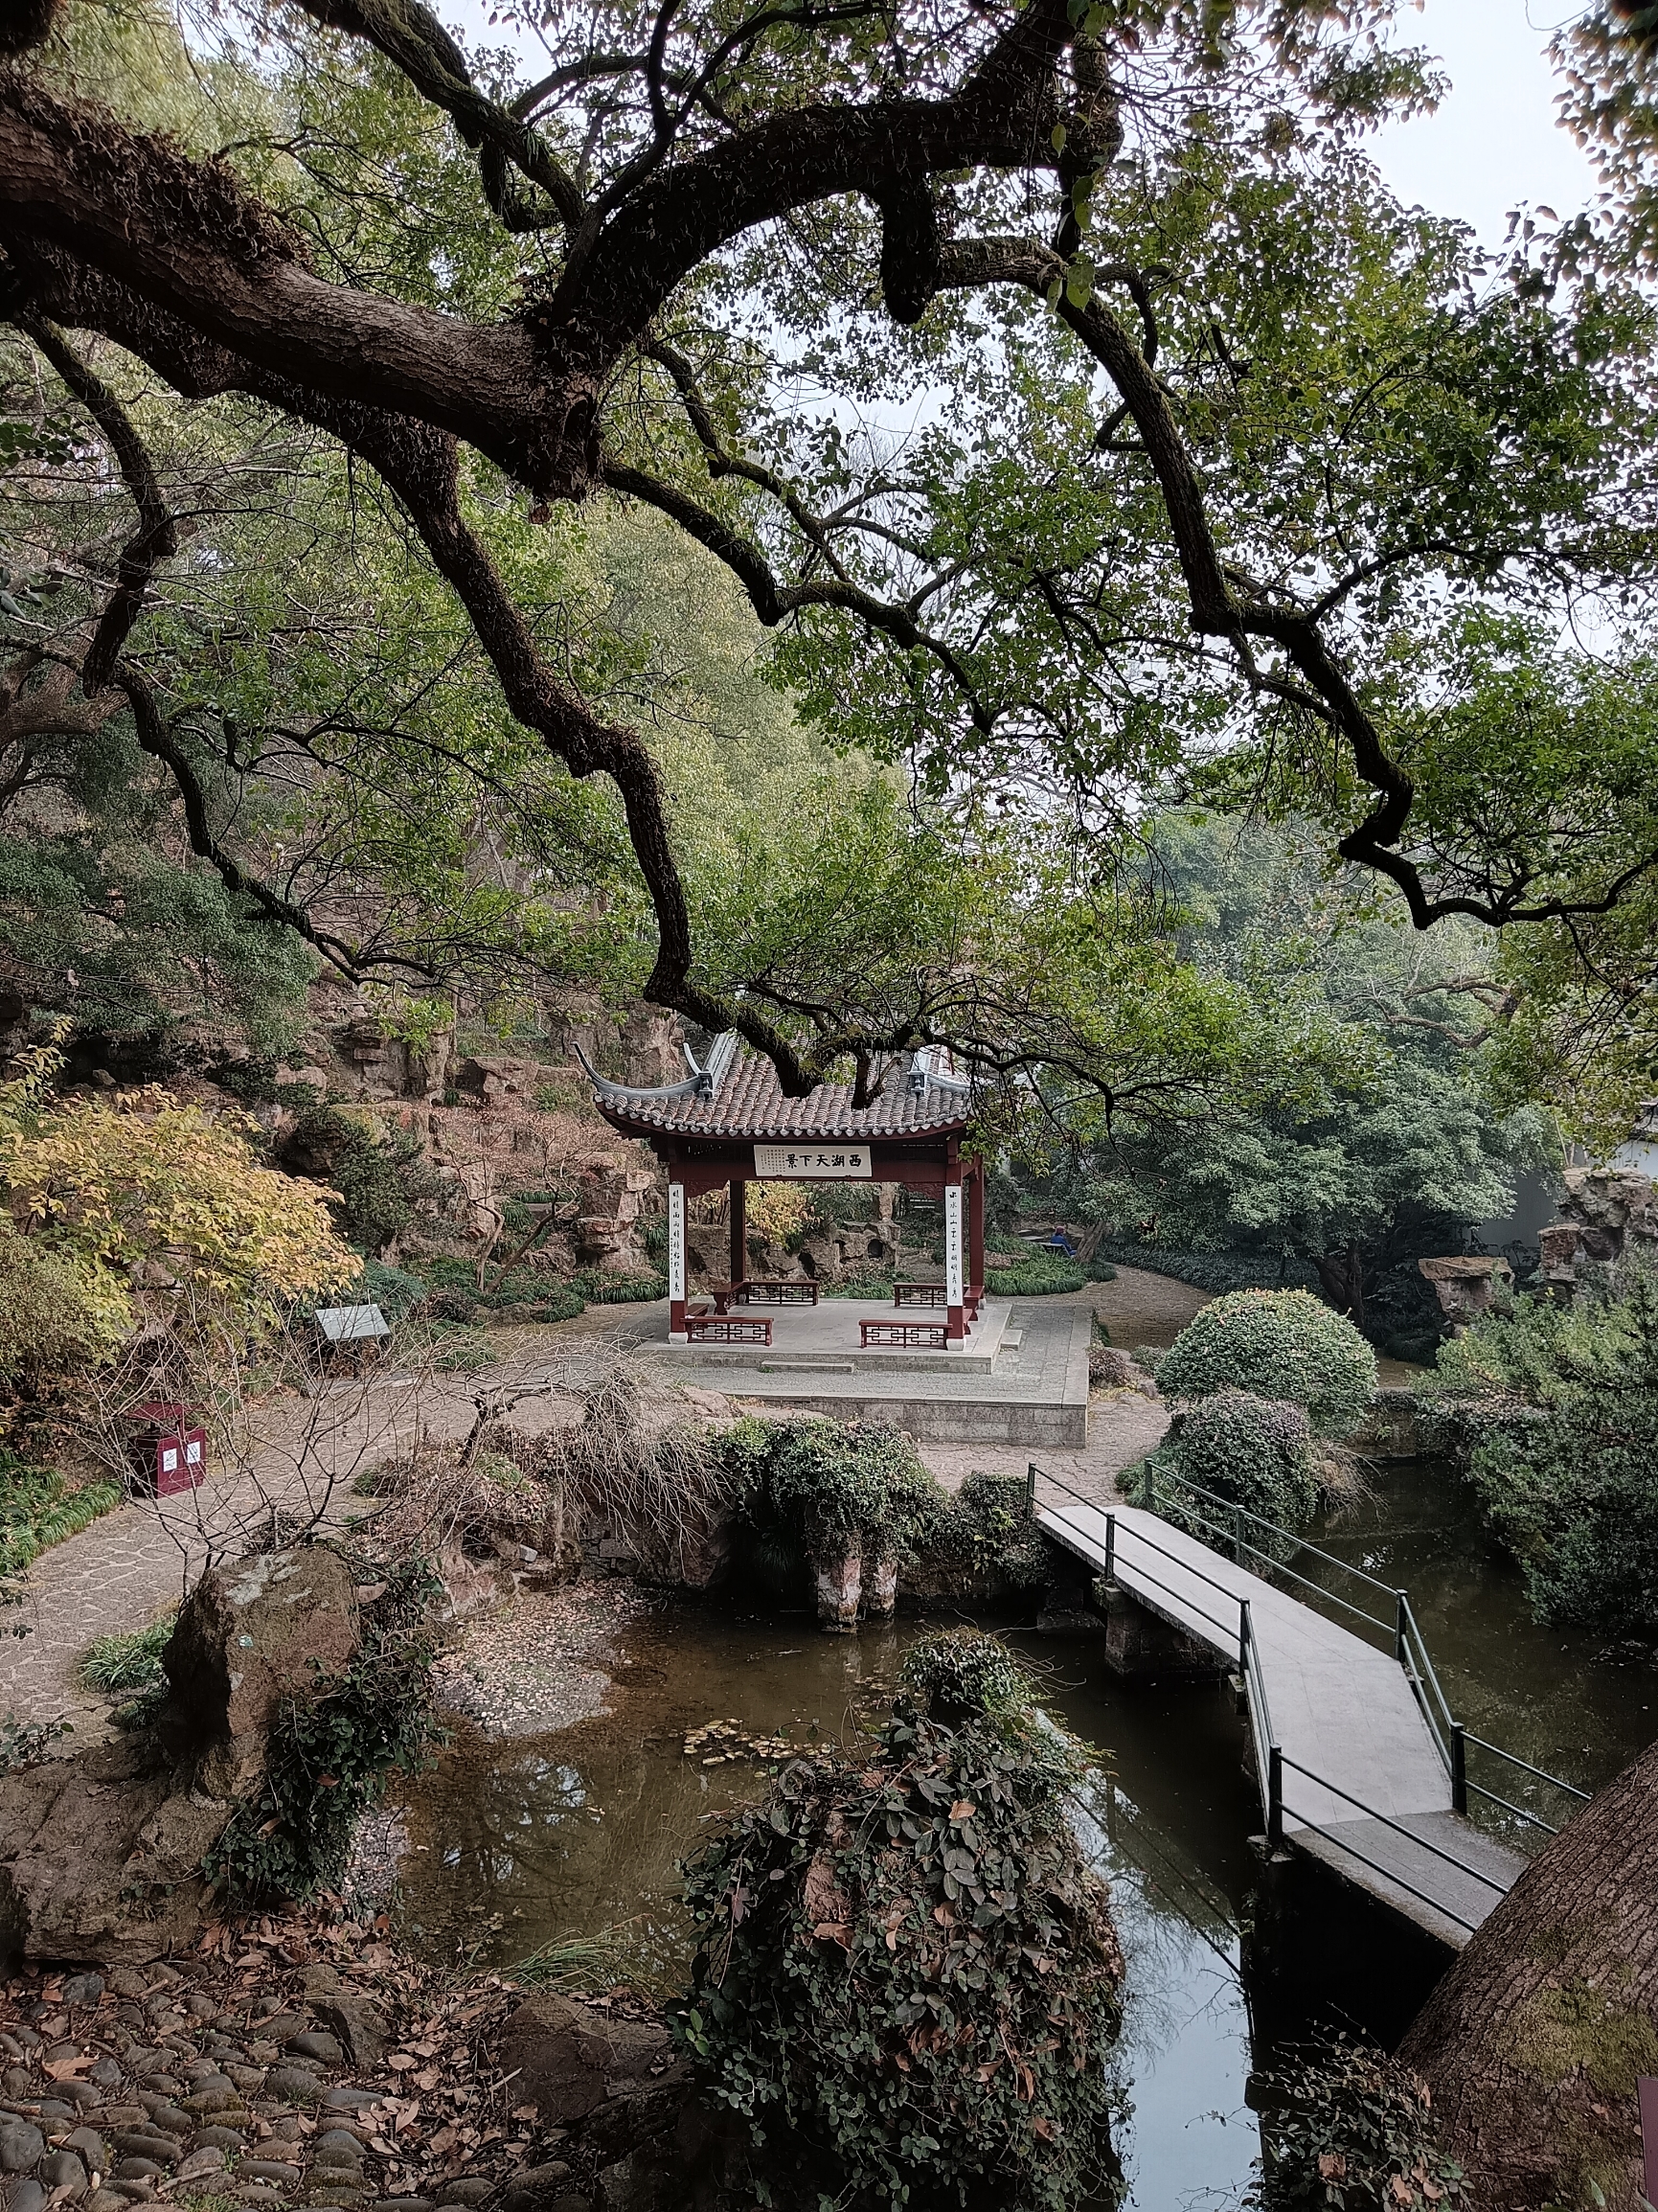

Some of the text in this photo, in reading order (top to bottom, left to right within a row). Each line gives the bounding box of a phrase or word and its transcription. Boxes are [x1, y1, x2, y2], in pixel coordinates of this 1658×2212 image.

[785, 1153, 862, 1169] 西湖天下景
